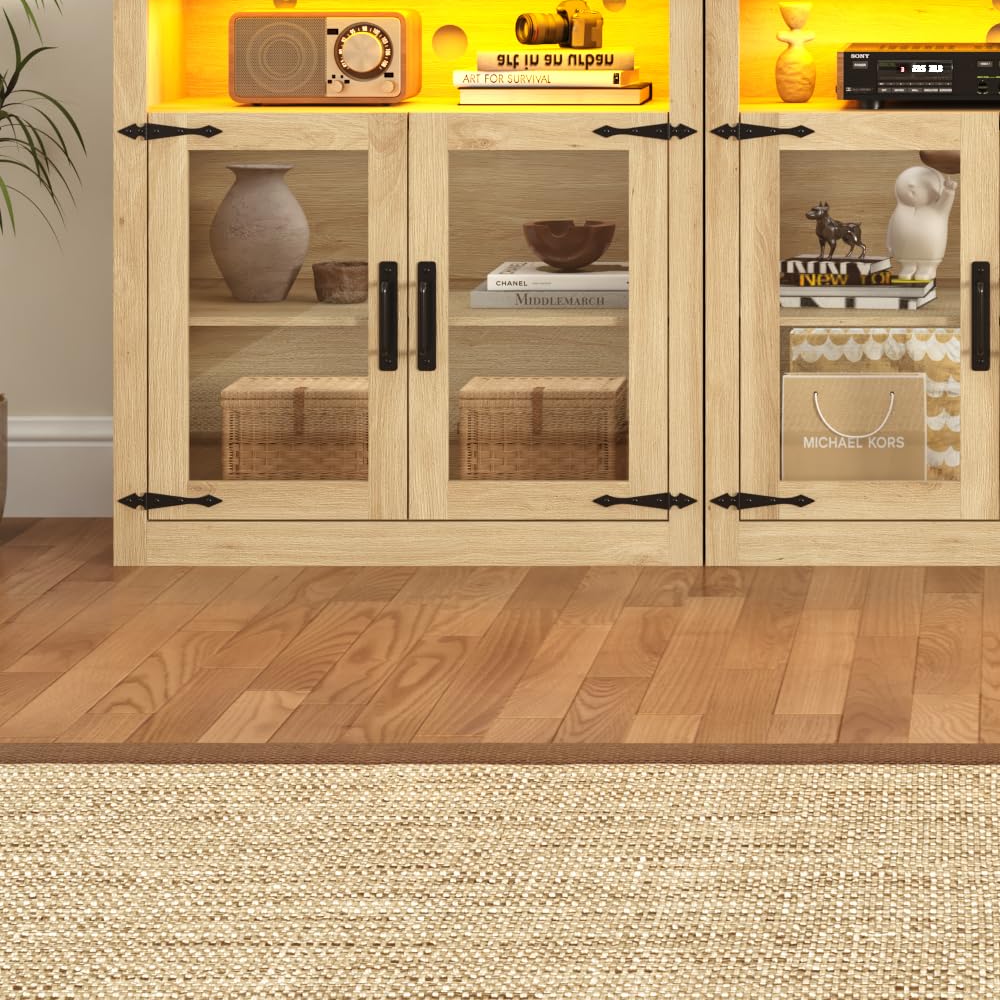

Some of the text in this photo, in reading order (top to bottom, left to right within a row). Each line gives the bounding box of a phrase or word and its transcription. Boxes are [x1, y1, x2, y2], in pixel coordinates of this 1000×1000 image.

[462, 74, 551, 84] ART FOR SURVIVAL
[514, 293, 605, 306] MIDDLEMARCH
[803, 436, 905, 449] MICHAEL KORS
